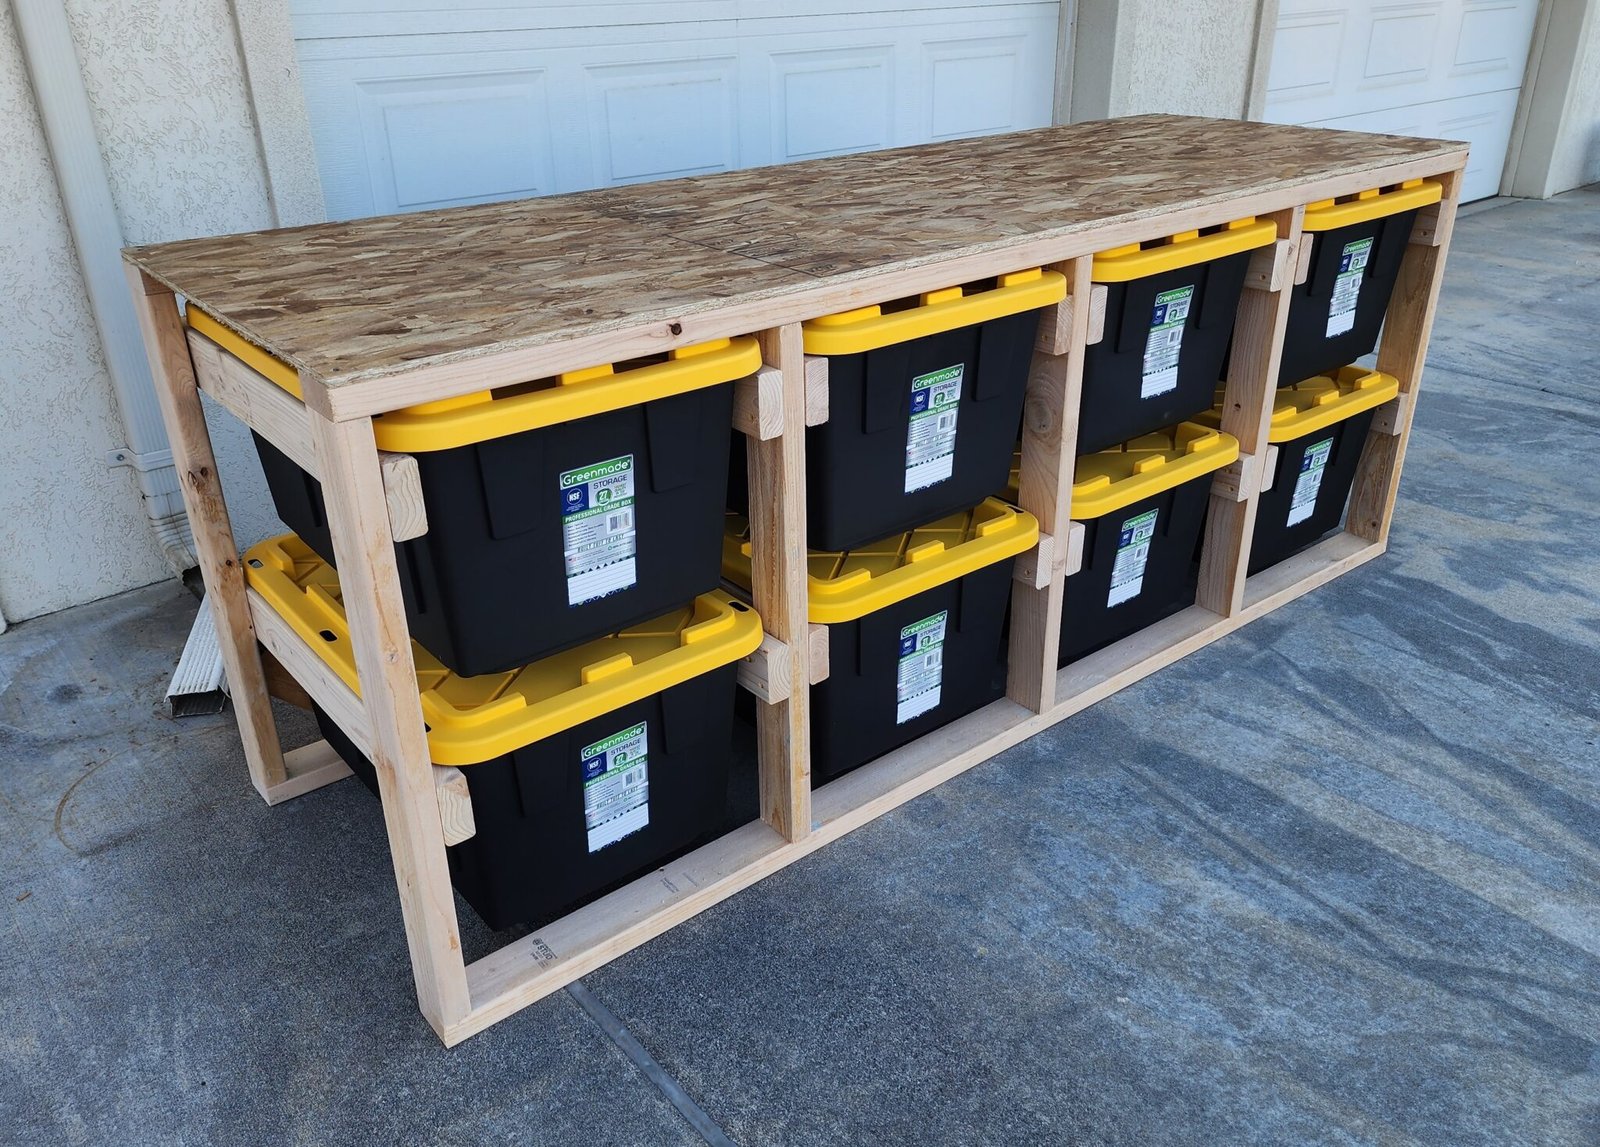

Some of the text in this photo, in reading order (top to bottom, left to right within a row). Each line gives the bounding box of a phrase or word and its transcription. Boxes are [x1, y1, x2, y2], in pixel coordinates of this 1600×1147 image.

[914, 369, 960, 389] Greenmade
[933, 381, 958, 393] STORAGE
[563, 459, 629, 486] Greenmade
[593, 474, 628, 490] STORAGE
[569, 491, 580, 502] NSF
[599, 490, 608, 500] 27
[565, 507, 603, 524] PROFESSIONAL
[603, 502, 621, 513] GRADE
[621, 498, 632, 508] BOX
[902, 615, 944, 636] Greenmade
[584, 726, 643, 757] Greenmade
[611, 738, 641, 756] STORAGE
[589, 760, 599, 770] NSF
[538, 945, 553, 960] STUD
